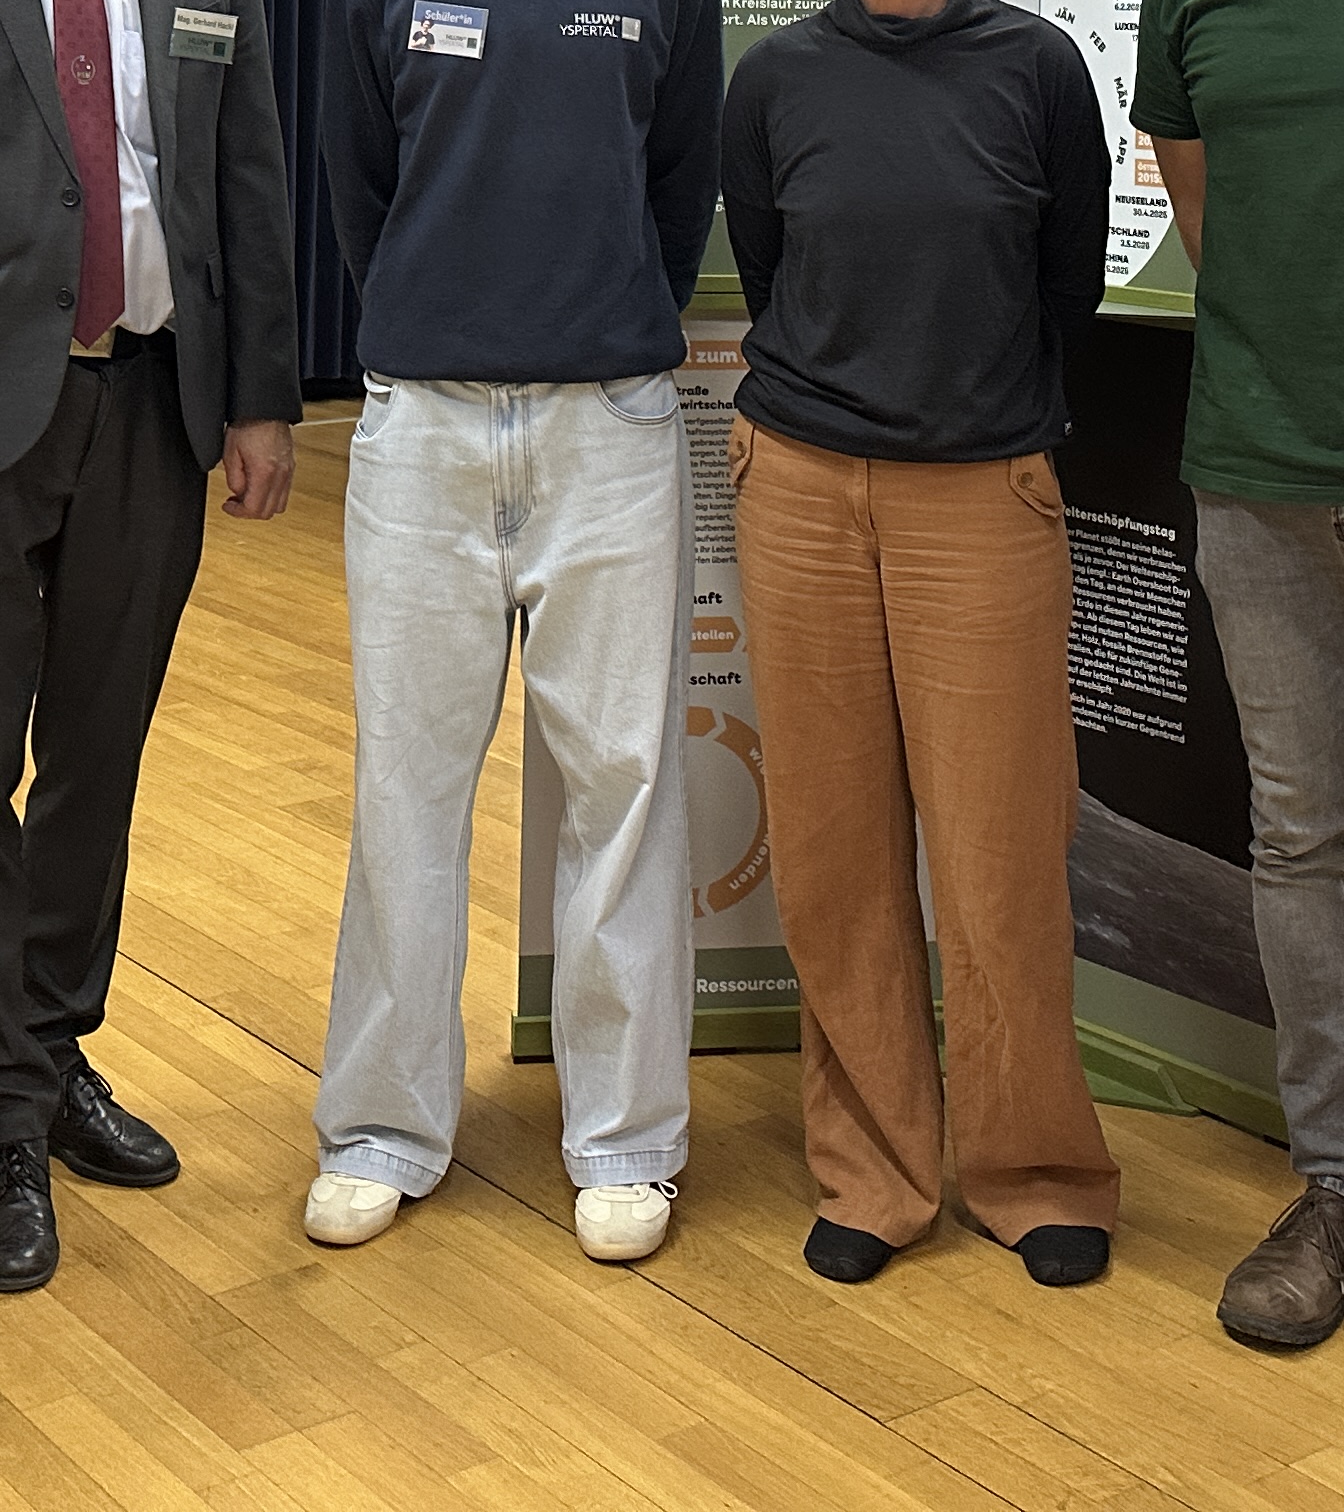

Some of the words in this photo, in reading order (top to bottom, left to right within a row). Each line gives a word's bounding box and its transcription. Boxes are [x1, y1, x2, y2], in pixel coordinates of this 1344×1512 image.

[1054, 6, 1077, 25] JÄN
[559, 24, 618, 38] YSPERTAL
[1089, 30, 1107, 53] FEB
[1113, 77, 1127, 109] MÄR
[1115, 136, 1128, 166] APR
[1115, 194, 1168, 208] NEUSEELAND
[695, 348, 738, 364] zum
[1064, 505, 1176, 541] elterschöpfungstag
[696, 978, 798, 993] Ressourcen
